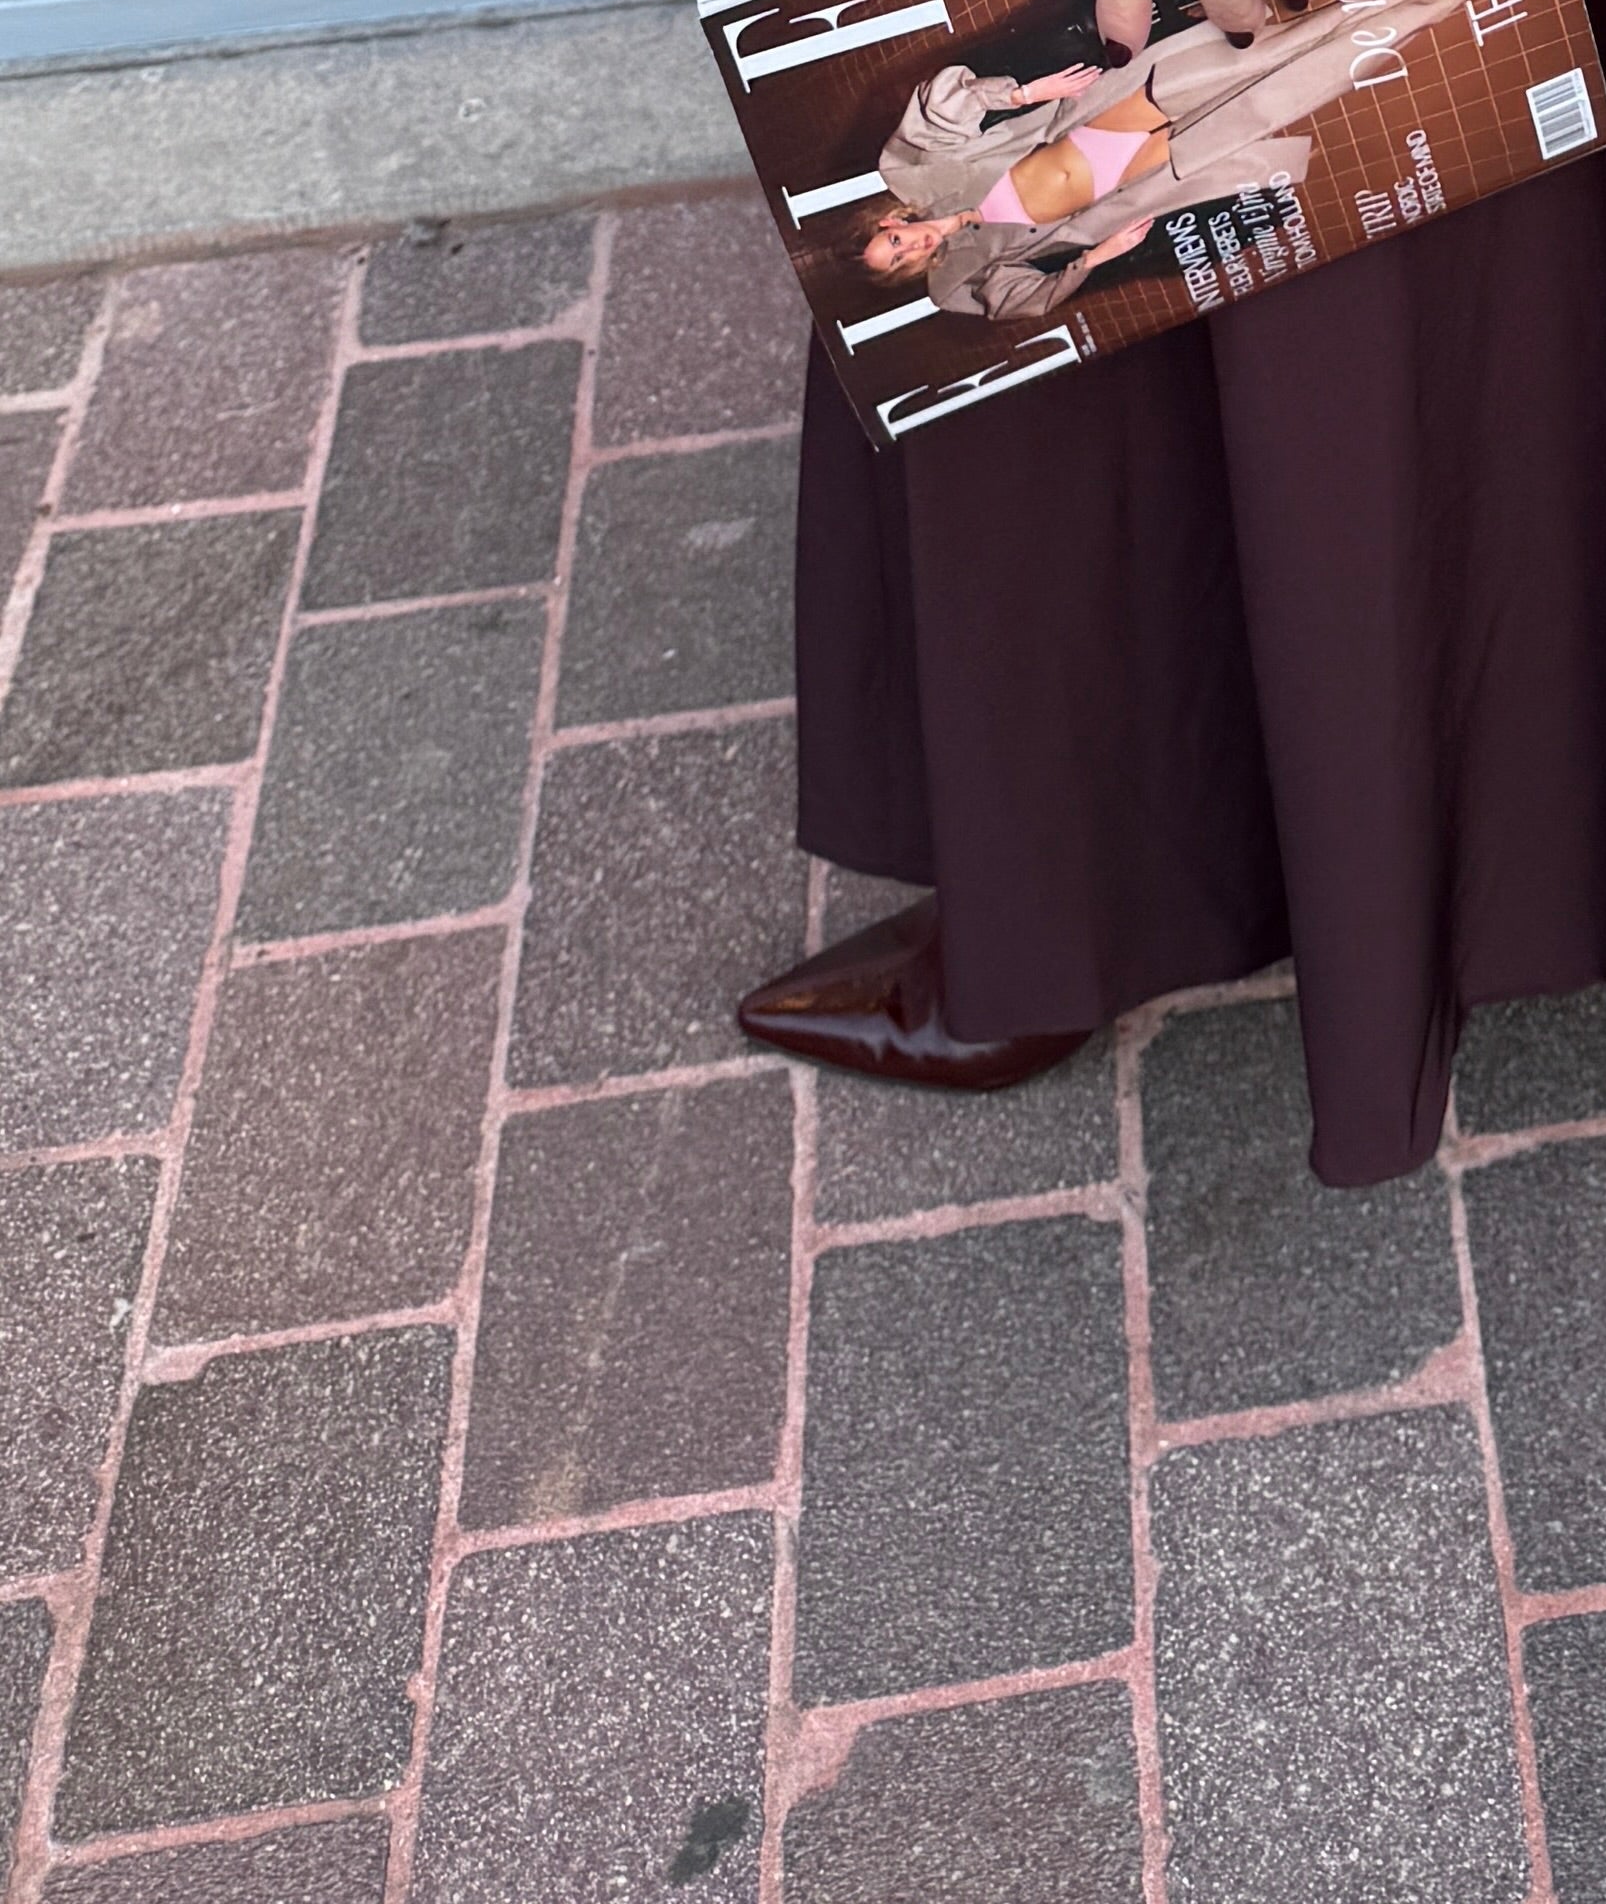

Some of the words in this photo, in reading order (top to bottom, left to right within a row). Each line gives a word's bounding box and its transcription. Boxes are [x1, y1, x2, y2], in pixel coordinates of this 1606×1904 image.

[1350, 26, 1408, 90] De
[1269, 171, 1311, 241] HOLLAND
[1354, 189, 1397, 240] TRIP
[1293, 236, 1318, 270] TOM
